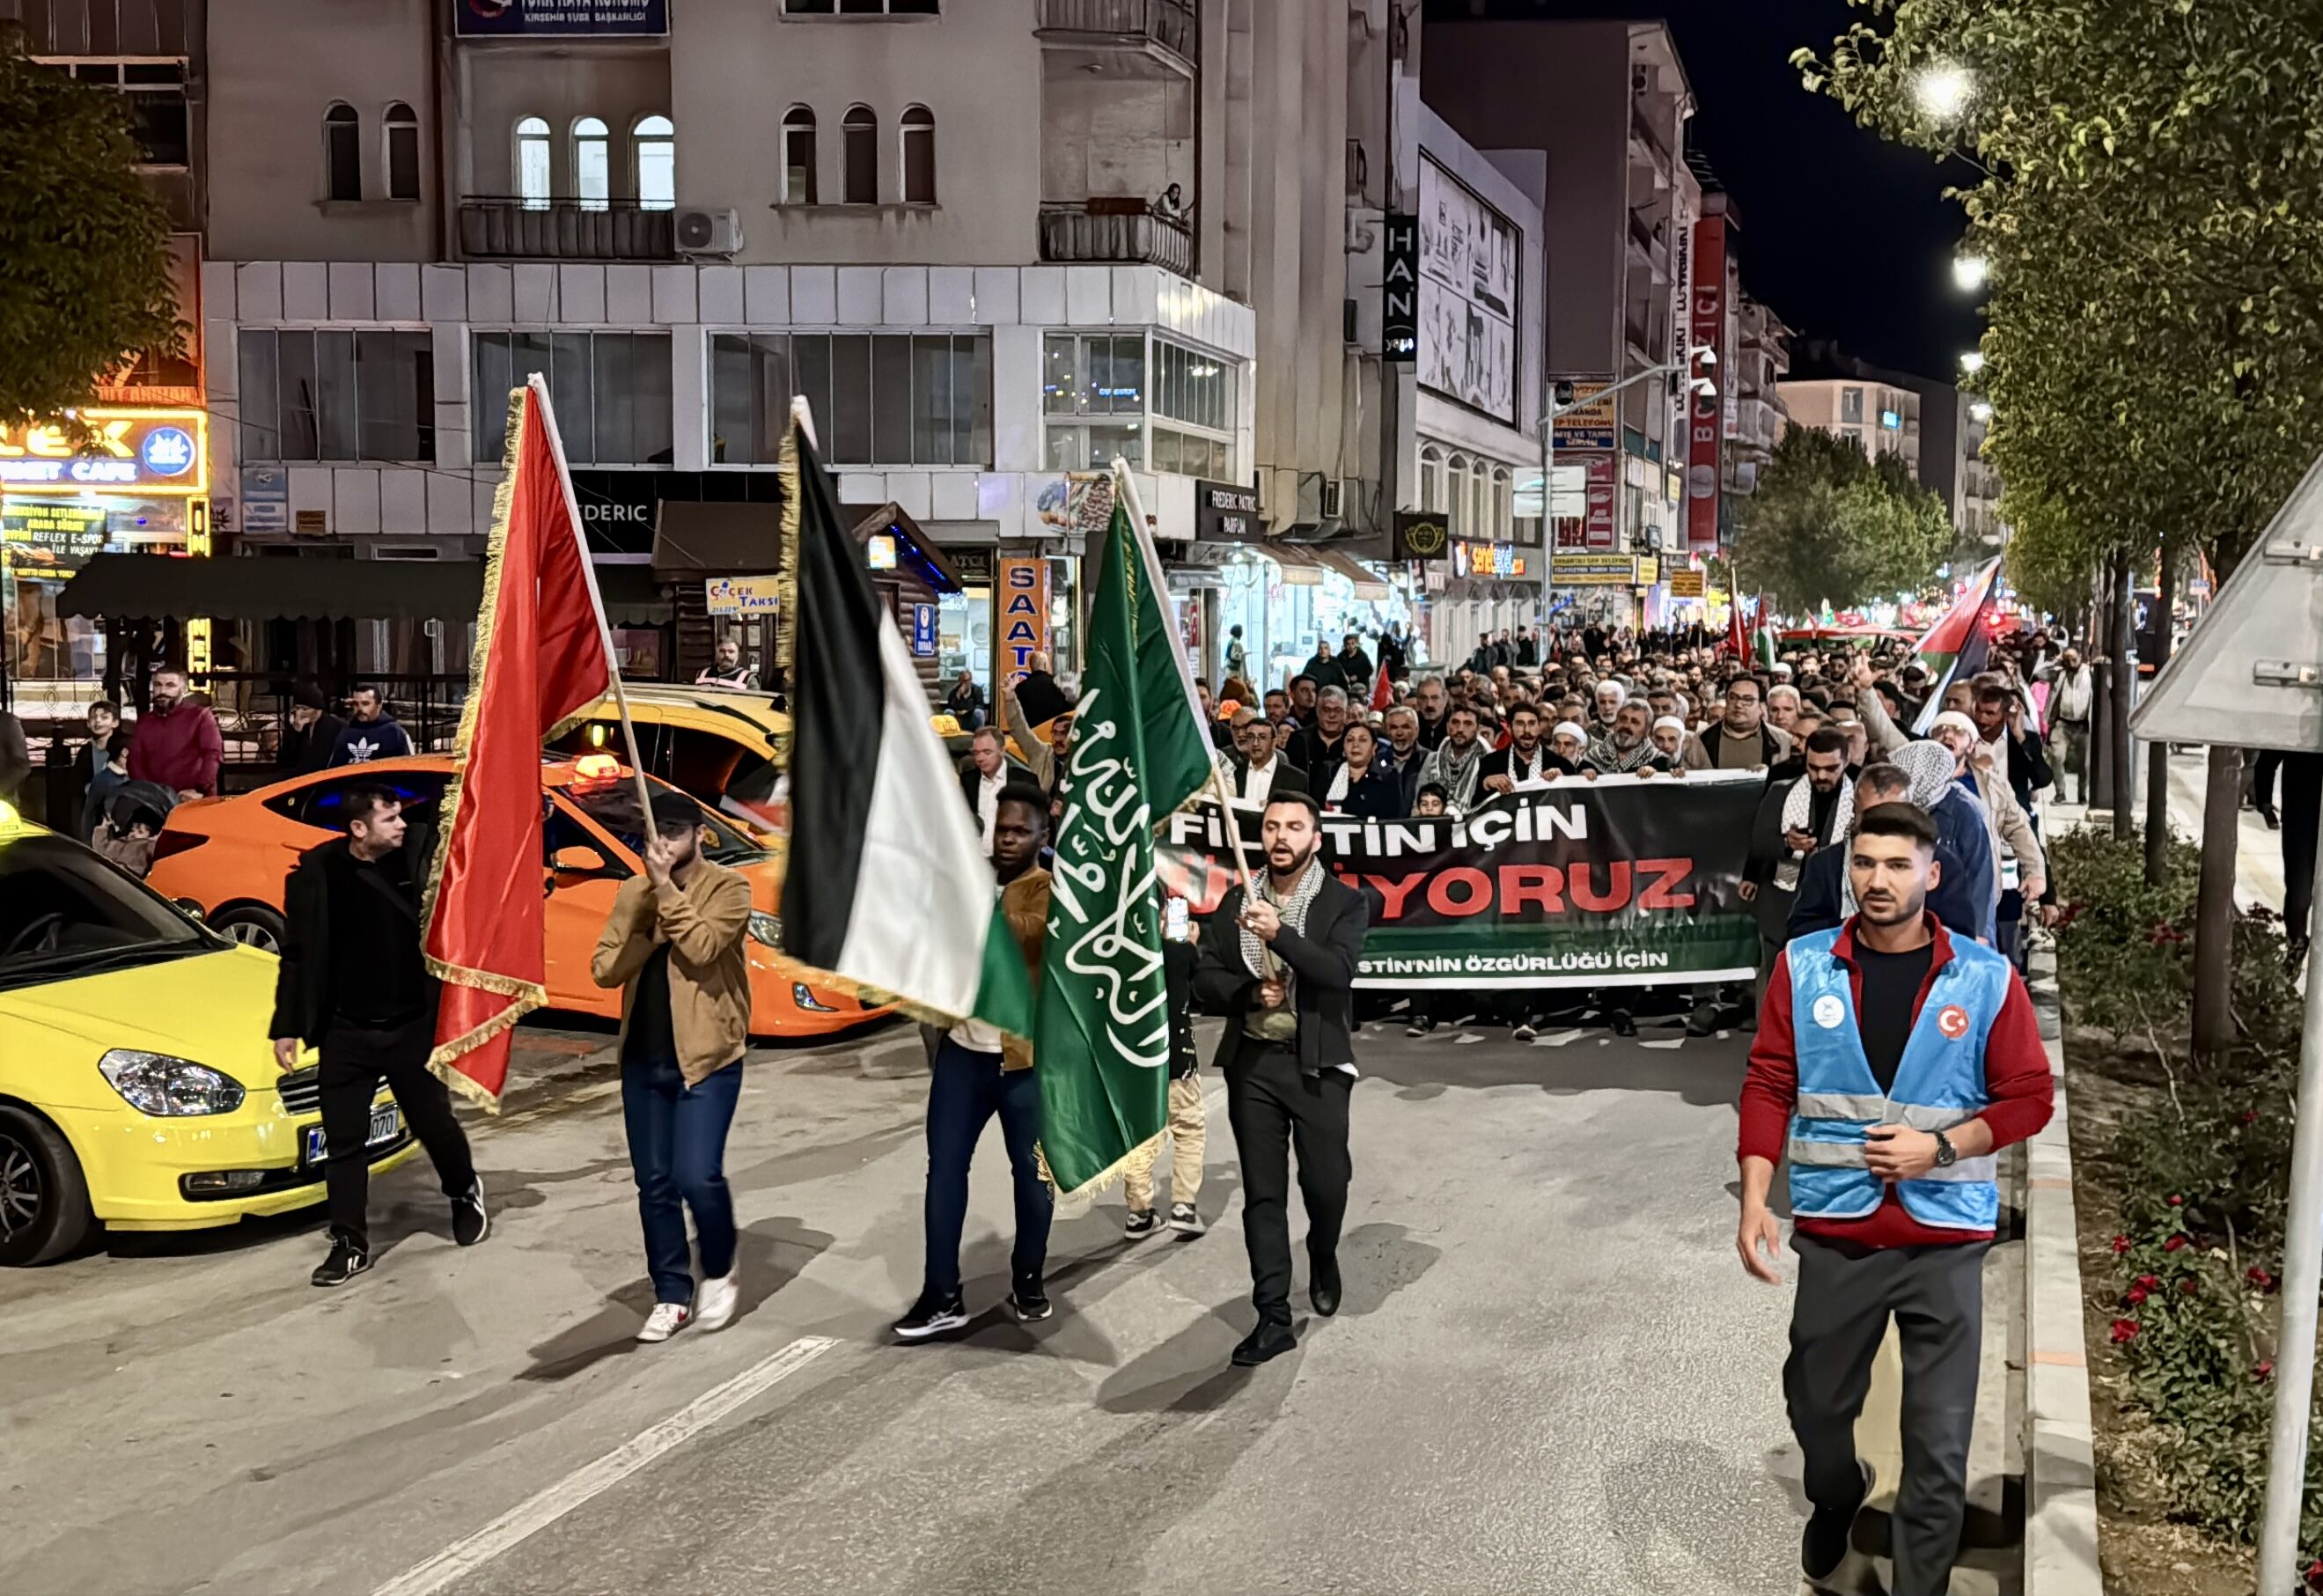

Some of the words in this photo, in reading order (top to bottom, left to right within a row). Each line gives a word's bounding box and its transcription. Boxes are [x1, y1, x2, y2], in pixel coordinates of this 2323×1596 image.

[577, 504, 648, 521] DERIC
[33, 531, 67, 543] REFLEX
[1170, 807, 1436, 857] FİLTİN
[1451, 798, 1588, 851] İÇİN
[1465, 951, 1615, 972] ÖZGÜRLÜĞÜ
[1616, 950, 1669, 969] İÇİN
